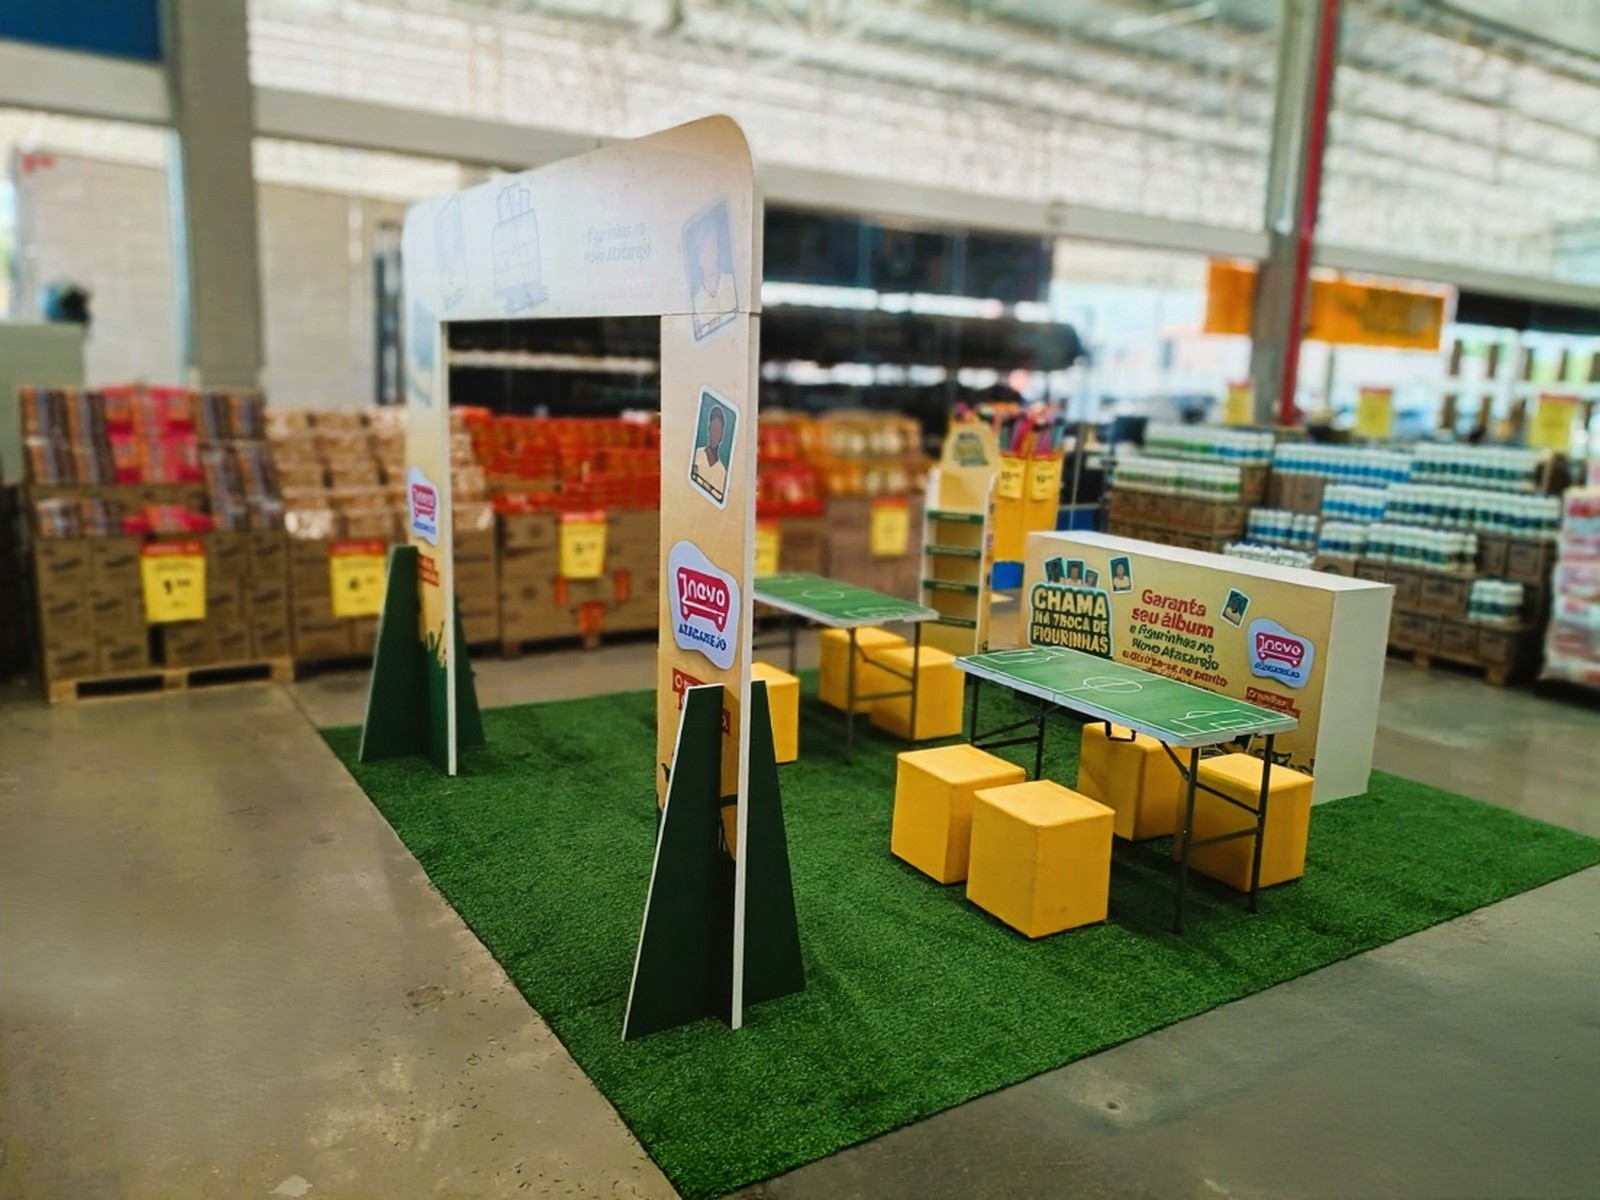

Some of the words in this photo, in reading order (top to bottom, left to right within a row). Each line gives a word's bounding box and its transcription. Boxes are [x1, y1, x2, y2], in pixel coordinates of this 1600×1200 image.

[1034, 587, 1108, 618] CHAMA
[1141, 589, 1207, 617] Garanta
[1053, 613, 1090, 632] TROCA
[1093, 620, 1108, 635] DE
[1131, 608, 1159, 624] seu
[1161, 612, 1214, 639] álbum
[1138, 624, 1197, 650] figurinhas
[1033, 625, 1109, 654] FIGURINHAS
